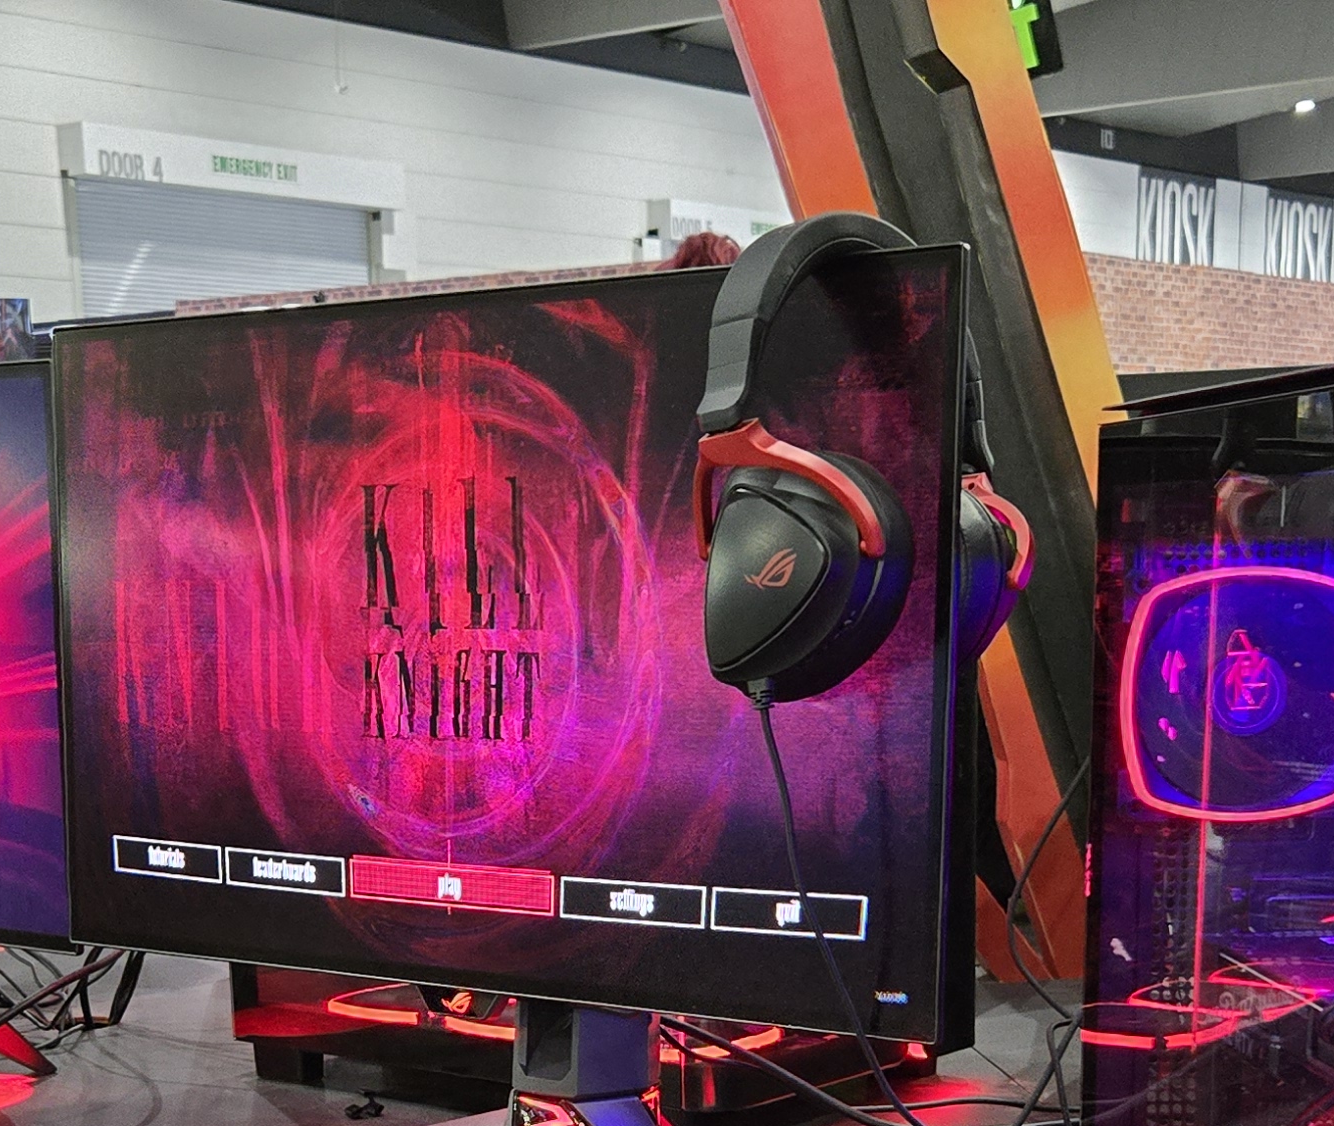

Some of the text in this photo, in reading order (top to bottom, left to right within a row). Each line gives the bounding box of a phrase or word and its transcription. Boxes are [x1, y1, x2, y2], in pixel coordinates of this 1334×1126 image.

[98, 149, 163, 183] DOOR 4
[212, 155, 298, 182] EMERGENCY EXIT
[1139, 176, 1215, 266] KIOSK
[1267, 198, 1332, 283] KIOSK
[359, 472, 544, 640] KILL
[359, 646, 540, 742] KNIGHT
[147, 845, 186, 869] tutorials
[252, 856, 317, 884] leaderboards
[437, 873, 463, 901] play
[609, 888, 655, 917] settings
